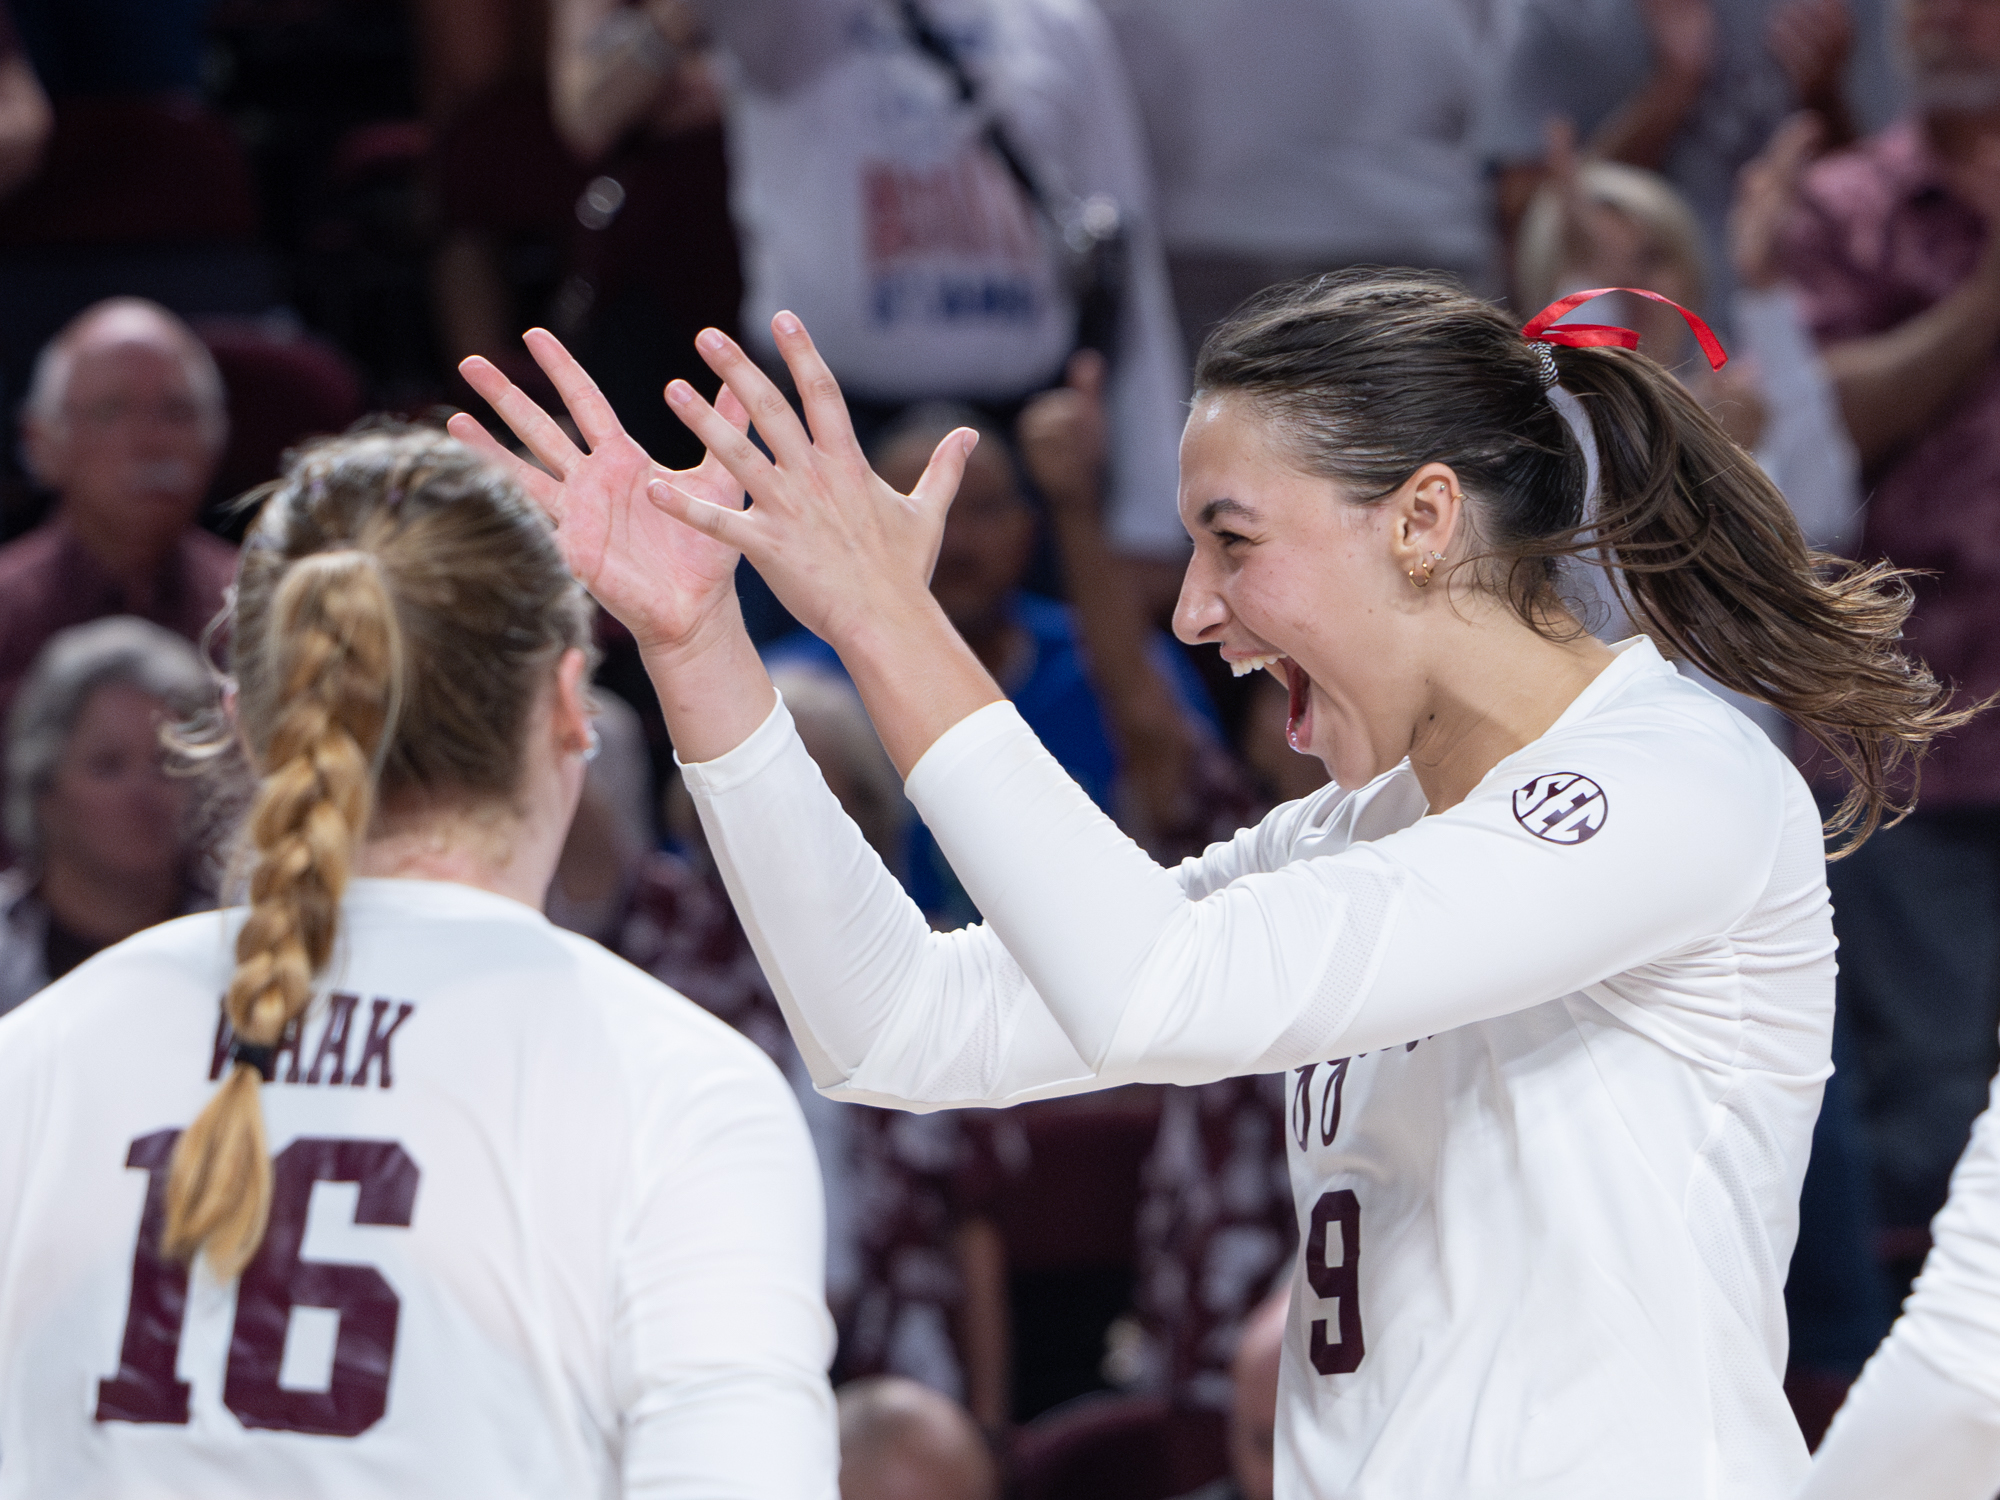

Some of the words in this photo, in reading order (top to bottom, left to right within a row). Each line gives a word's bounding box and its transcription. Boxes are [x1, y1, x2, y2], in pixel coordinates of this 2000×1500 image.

[1512, 771, 1608, 845] SEC
[96, 1127, 421, 1437] 16
[1306, 1189, 1365, 1375] 9
